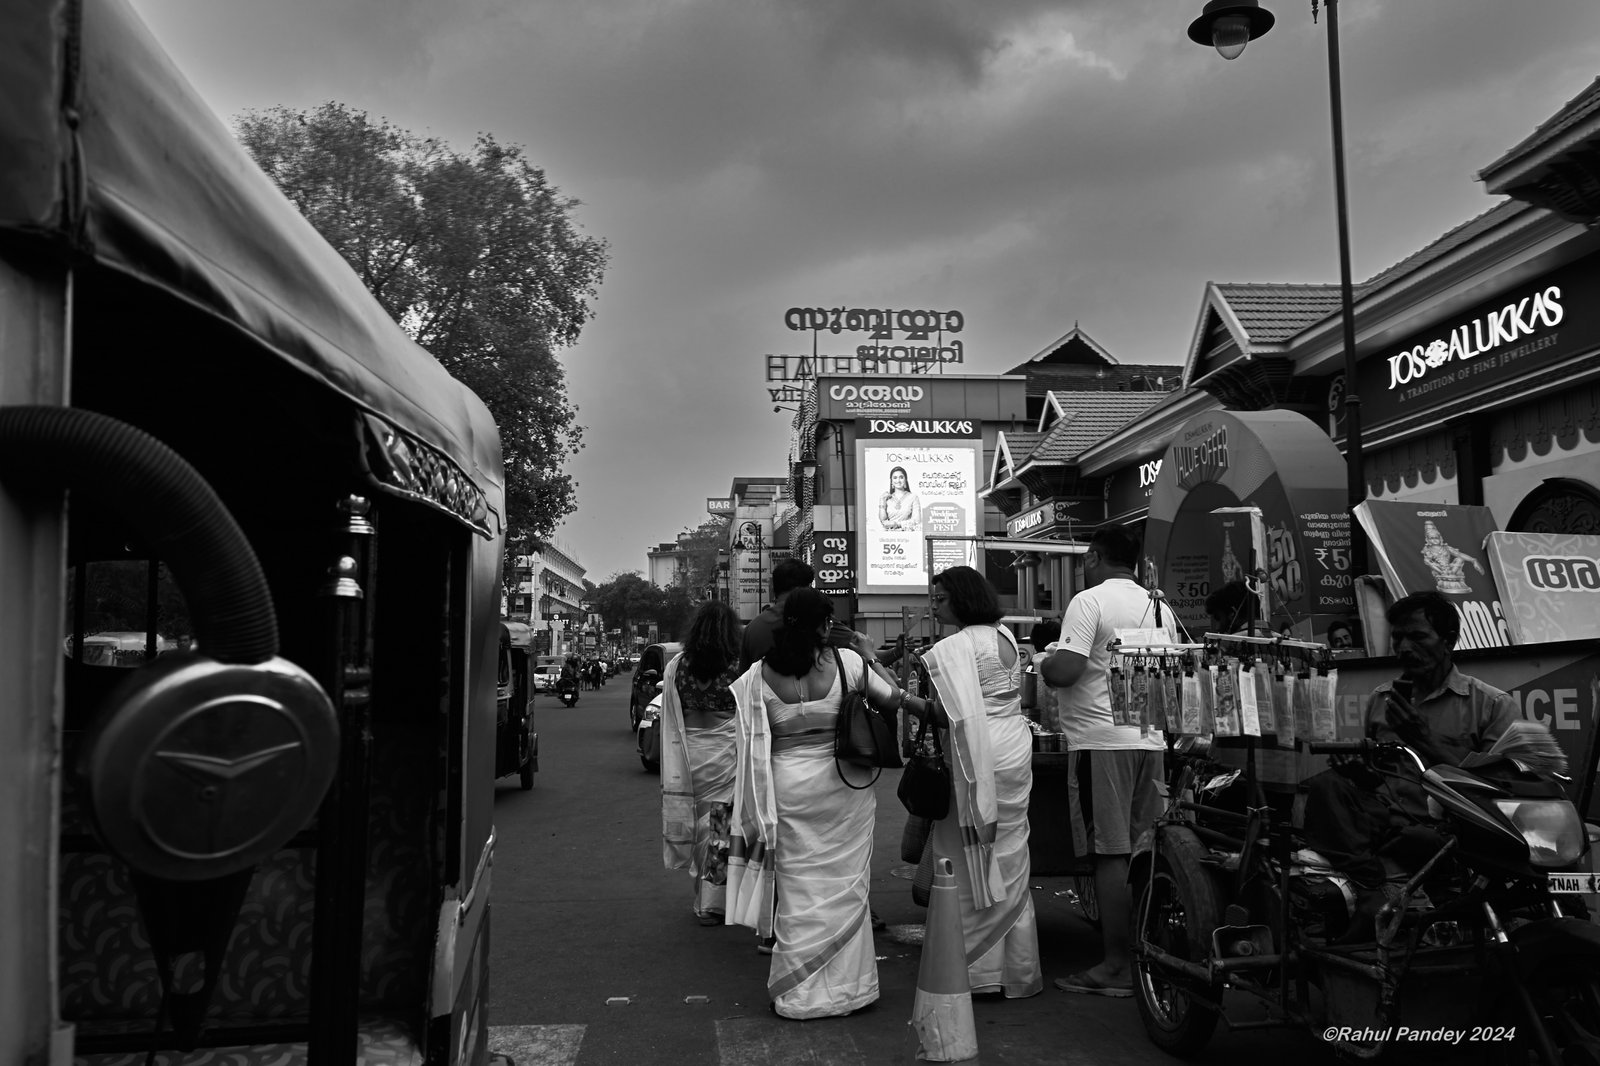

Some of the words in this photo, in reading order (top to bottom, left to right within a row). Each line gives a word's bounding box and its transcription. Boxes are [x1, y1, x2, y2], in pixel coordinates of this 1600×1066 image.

[1387, 345, 1426, 390] JOS
[1448, 286, 1564, 361] ALUKKAS
[1407, 374, 1455, 398] TRADITION
[1457, 366, 1471, 381] OF
[1473, 357, 1497, 375] FINE
[1500, 333, 1559, 367] JEWELLERY
[829, 385, 924, 402] ഗരുഡ
[869, 420, 896, 433] JOS
[908, 420, 973, 434] ALUKKAS
[886, 453, 902, 462] JOS
[912, 454, 954, 463] ALUKKAS
[1172, 446, 1199, 486] VALUE
[1200, 424, 1230, 468] OFFER
[1138, 460, 1157, 488] JOS
[708, 501, 731, 509] BAR
[933, 524, 954, 532] FEST
[823, 538, 847, 551] സു
[883, 544, 904, 555] 5%
[1269, 528, 1296, 568] 50
[1313, 548, 1352, 571] ₹5
[1177, 581, 1210, 598] ₹50
[1319, 596, 1334, 605] JOS
